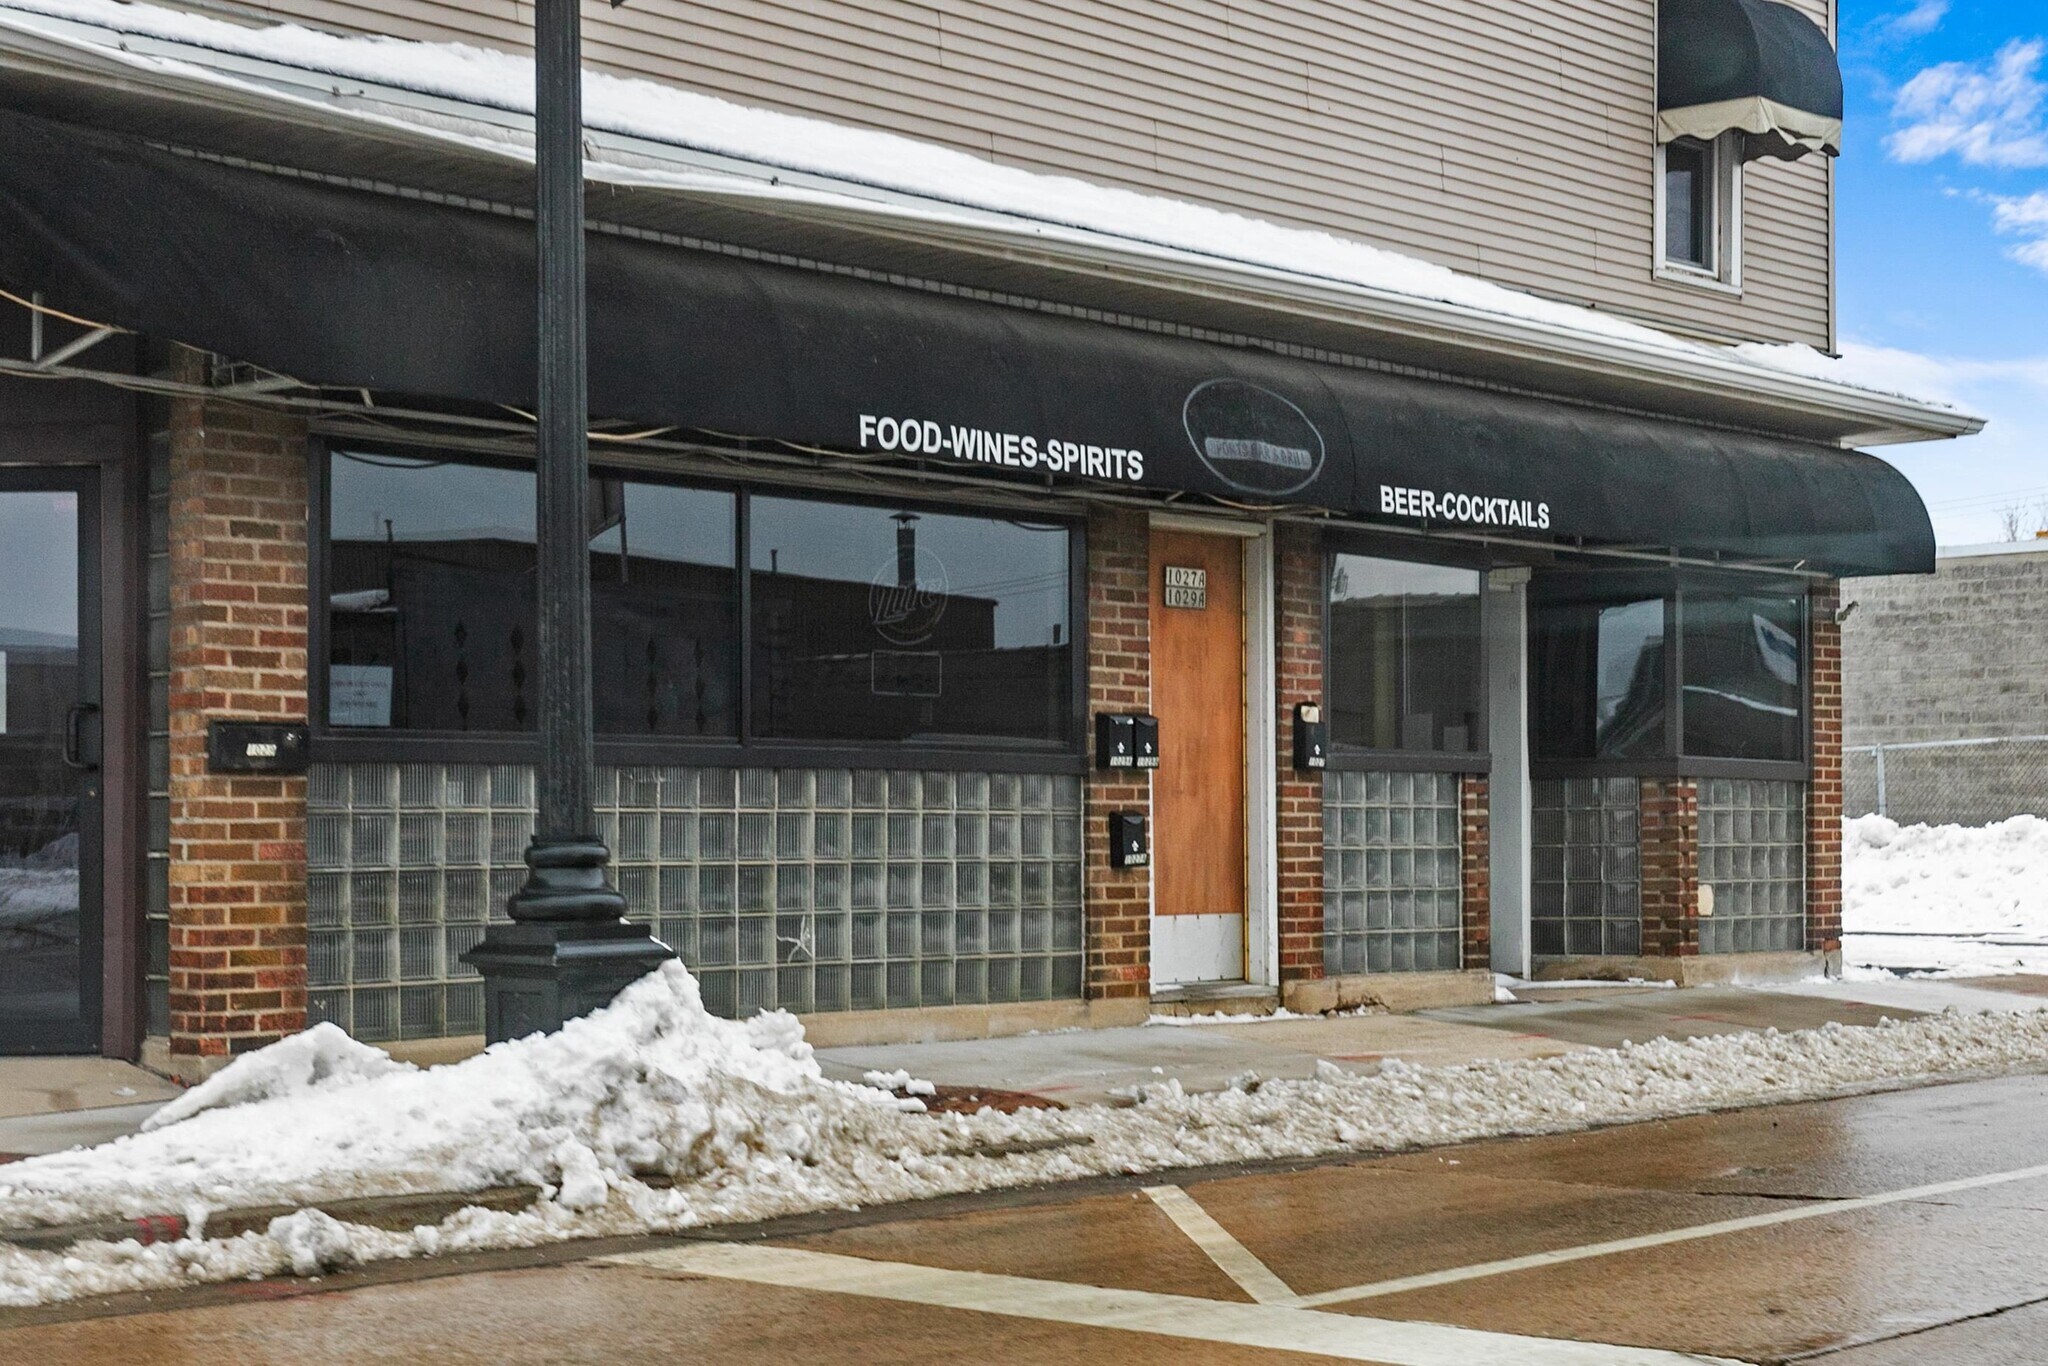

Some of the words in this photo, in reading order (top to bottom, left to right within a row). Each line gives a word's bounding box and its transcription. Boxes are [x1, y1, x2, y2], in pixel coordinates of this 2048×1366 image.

[859, 414, 1144, 480] FOOD-WINES-SPIRITS
[1380, 485, 1549, 529] BEER-COCKTAILS
[1168, 569, 1205, 587] 1027A
[1168, 588, 1204, 607] 1029A
